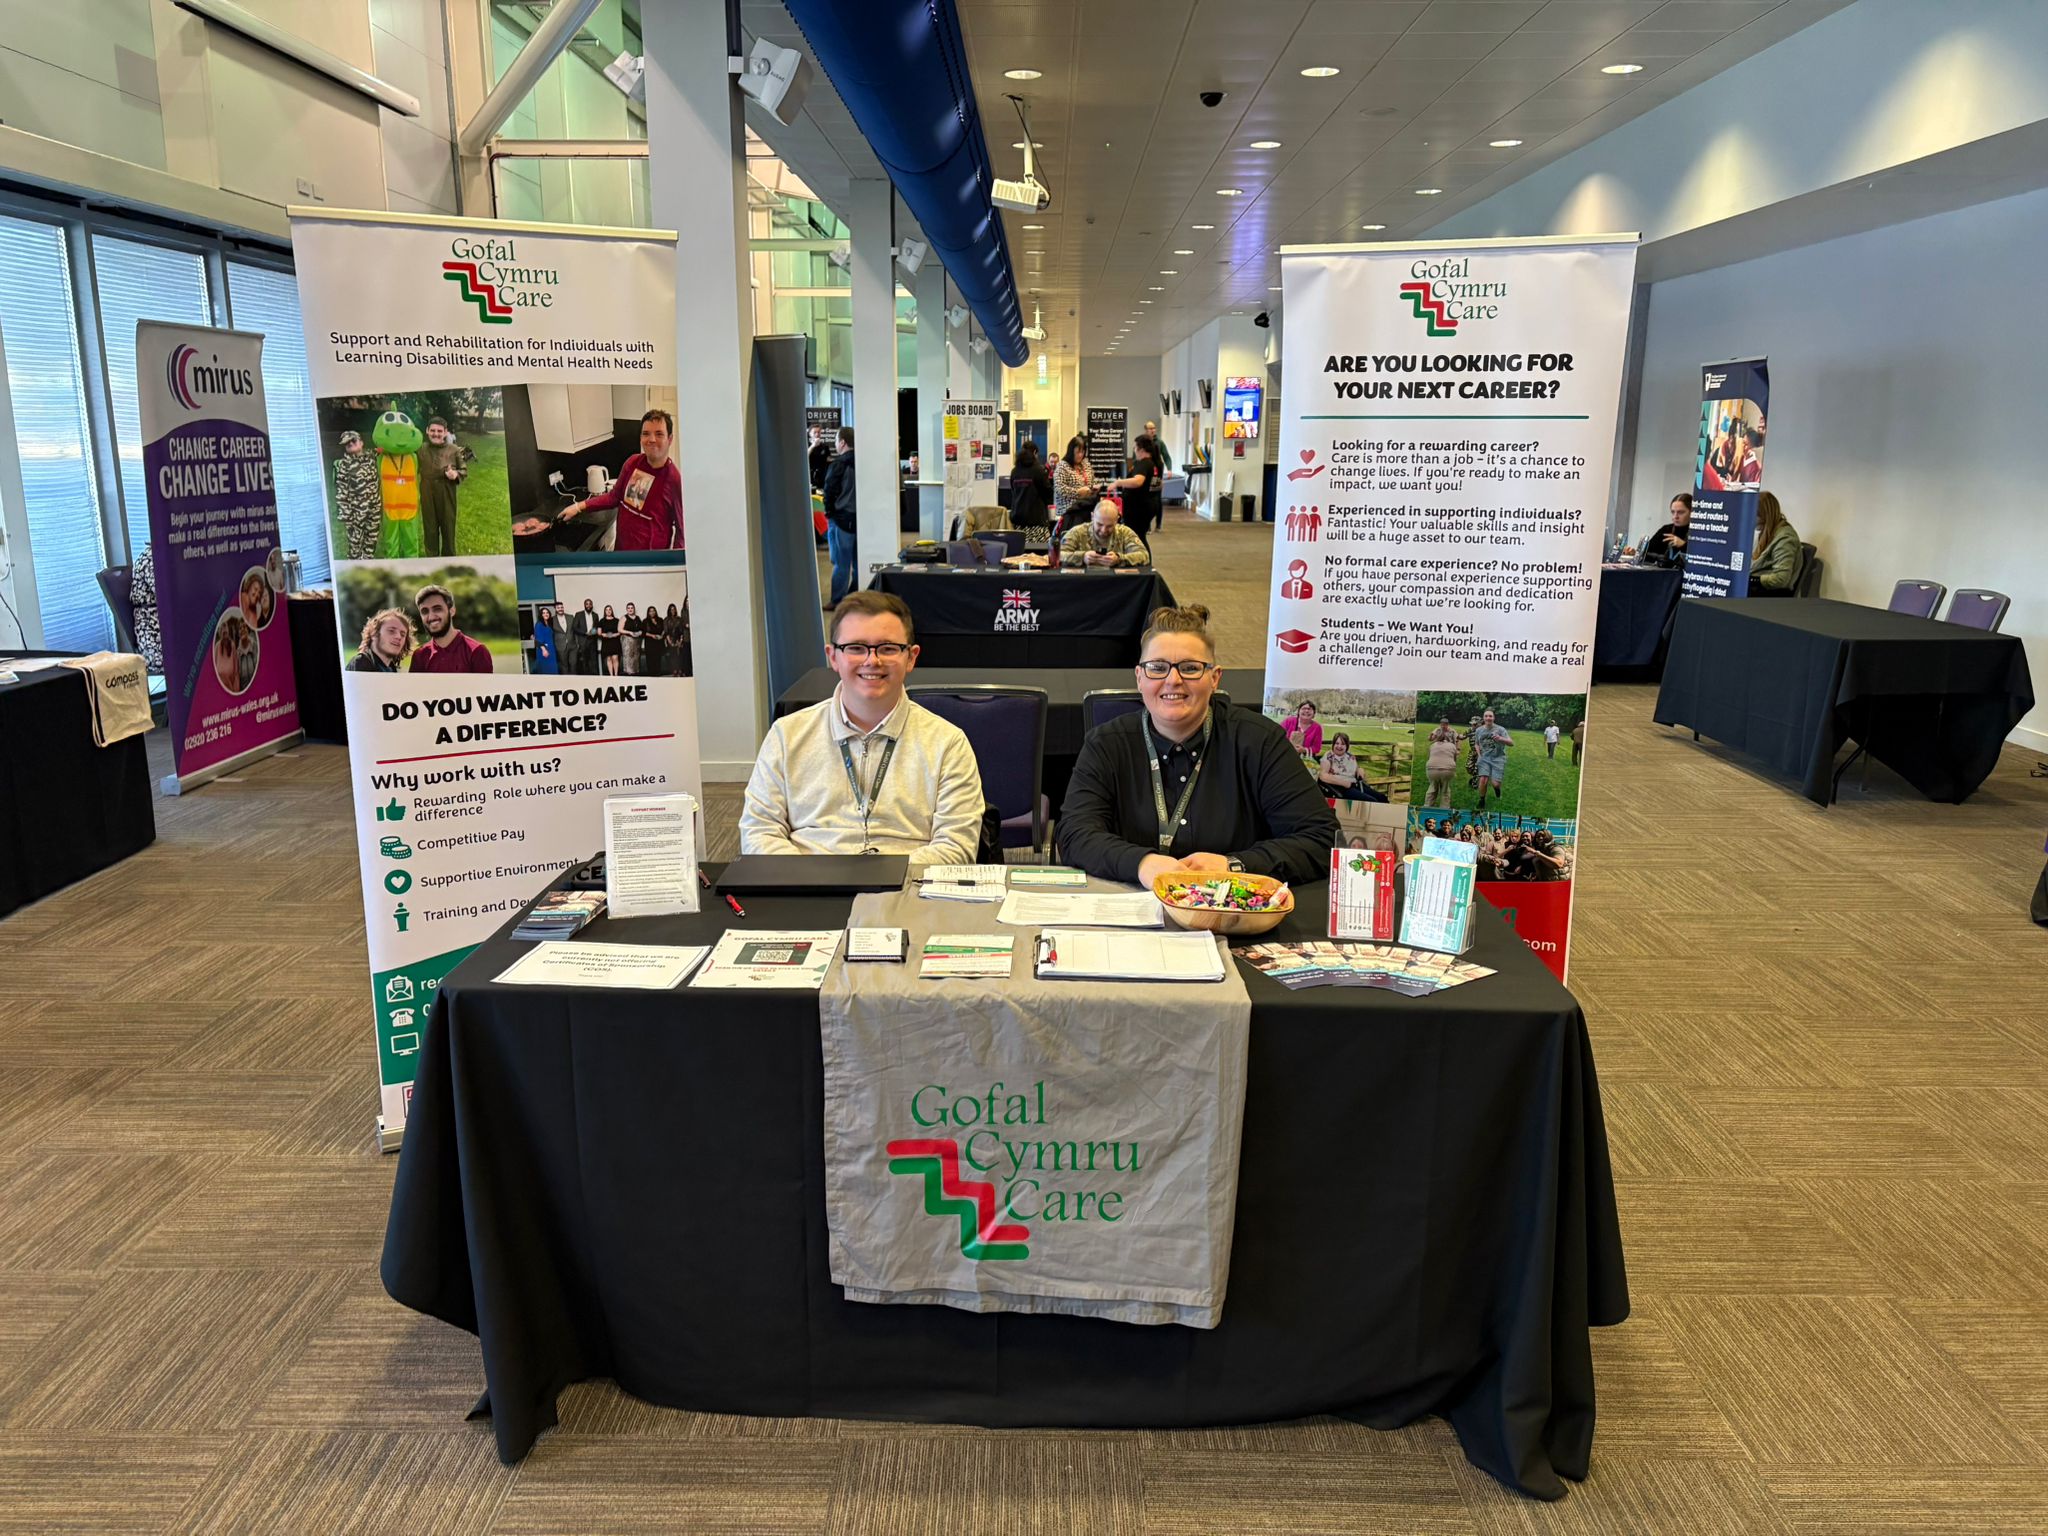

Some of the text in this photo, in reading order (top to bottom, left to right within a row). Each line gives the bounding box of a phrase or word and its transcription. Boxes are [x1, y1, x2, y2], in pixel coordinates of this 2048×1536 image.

[452, 238, 516, 261] Gofal
[478, 262, 559, 288] Cymru
[1411, 258, 1469, 279] Gofal
[499, 286, 553, 307] Care
[1432, 279, 1506, 304] Cymru
[1447, 301, 1499, 320] Care
[330, 332, 654, 353] Support and Rehabilitation for Individuals with
[336, 351, 653, 369] Learning Disabilities and Mental Health Needs
[1324, 353, 1573, 373] ARE YOU LOOKING FOR
[193, 354, 254, 395] mirus
[1333, 380, 1560, 399] YOUR NEXT CAREER?
[807, 411, 838, 420] DRIVER
[946, 405, 993, 416] JOBS BOARD
[1091, 411, 1124, 420] DRIVER
[169, 436, 266, 461] CHANGE CAREER
[1332, 440, 1539, 454] Looking for a rewarding career?
[1331, 453, 1585, 467] Care is more than a job it’s a chance to
[159, 463, 230, 499] CHANGE
[1330, 465, 1580, 481] change lives. If you're ready to make an
[1329, 479, 1462, 493] impact, we want you!
[170, 512, 188, 528] Begin
[190, 512, 204, 526] your
[205, 509, 229, 524] journey
[230, 506, 246, 519] with
[247, 505, 264, 518] mirus
[1328, 504, 1582, 520] Experienced in supporting individuals?
[168, 520, 274, 544] make a real difference to the lives
[1327, 517, 1585, 537] Fantastic! Your valuable skills and insight
[183, 537, 271, 560] others, as well as your own.
[1326, 530, 1525, 546] will be a huge asset to our team.
[1325, 555, 1582, 575] No formal care experience? No problem!
[994, 608, 1041, 624] ARMY
[1320, 618, 1474, 634] Students We Want You!
[993, 623, 1040, 632] BE THE BEST
[106, 670, 139, 689] compass
[256, 701, 296, 724] @miruswales
[382, 684, 648, 721] DO YOU WANT TO MAKE
[184, 724, 232, 751] 02920 236 216
[435, 713, 607, 744] A DIFFERENCE?
[371, 757, 561, 791] Why work with us?
[414, 774, 666, 808] Rewarding Role where you can make a
[415, 805, 483, 822] difference
[417, 829, 525, 850] Competitive Pay
[420, 869, 492, 887] Supportive
[495, 857, 579, 877] Environment
[423, 905, 478, 922] Training
[481, 901, 506, 914] and
[911, 1080, 1049, 1127] Gofal
[964, 1130, 1143, 1182] Cymru
[1005, 1178, 1124, 1222] Care
